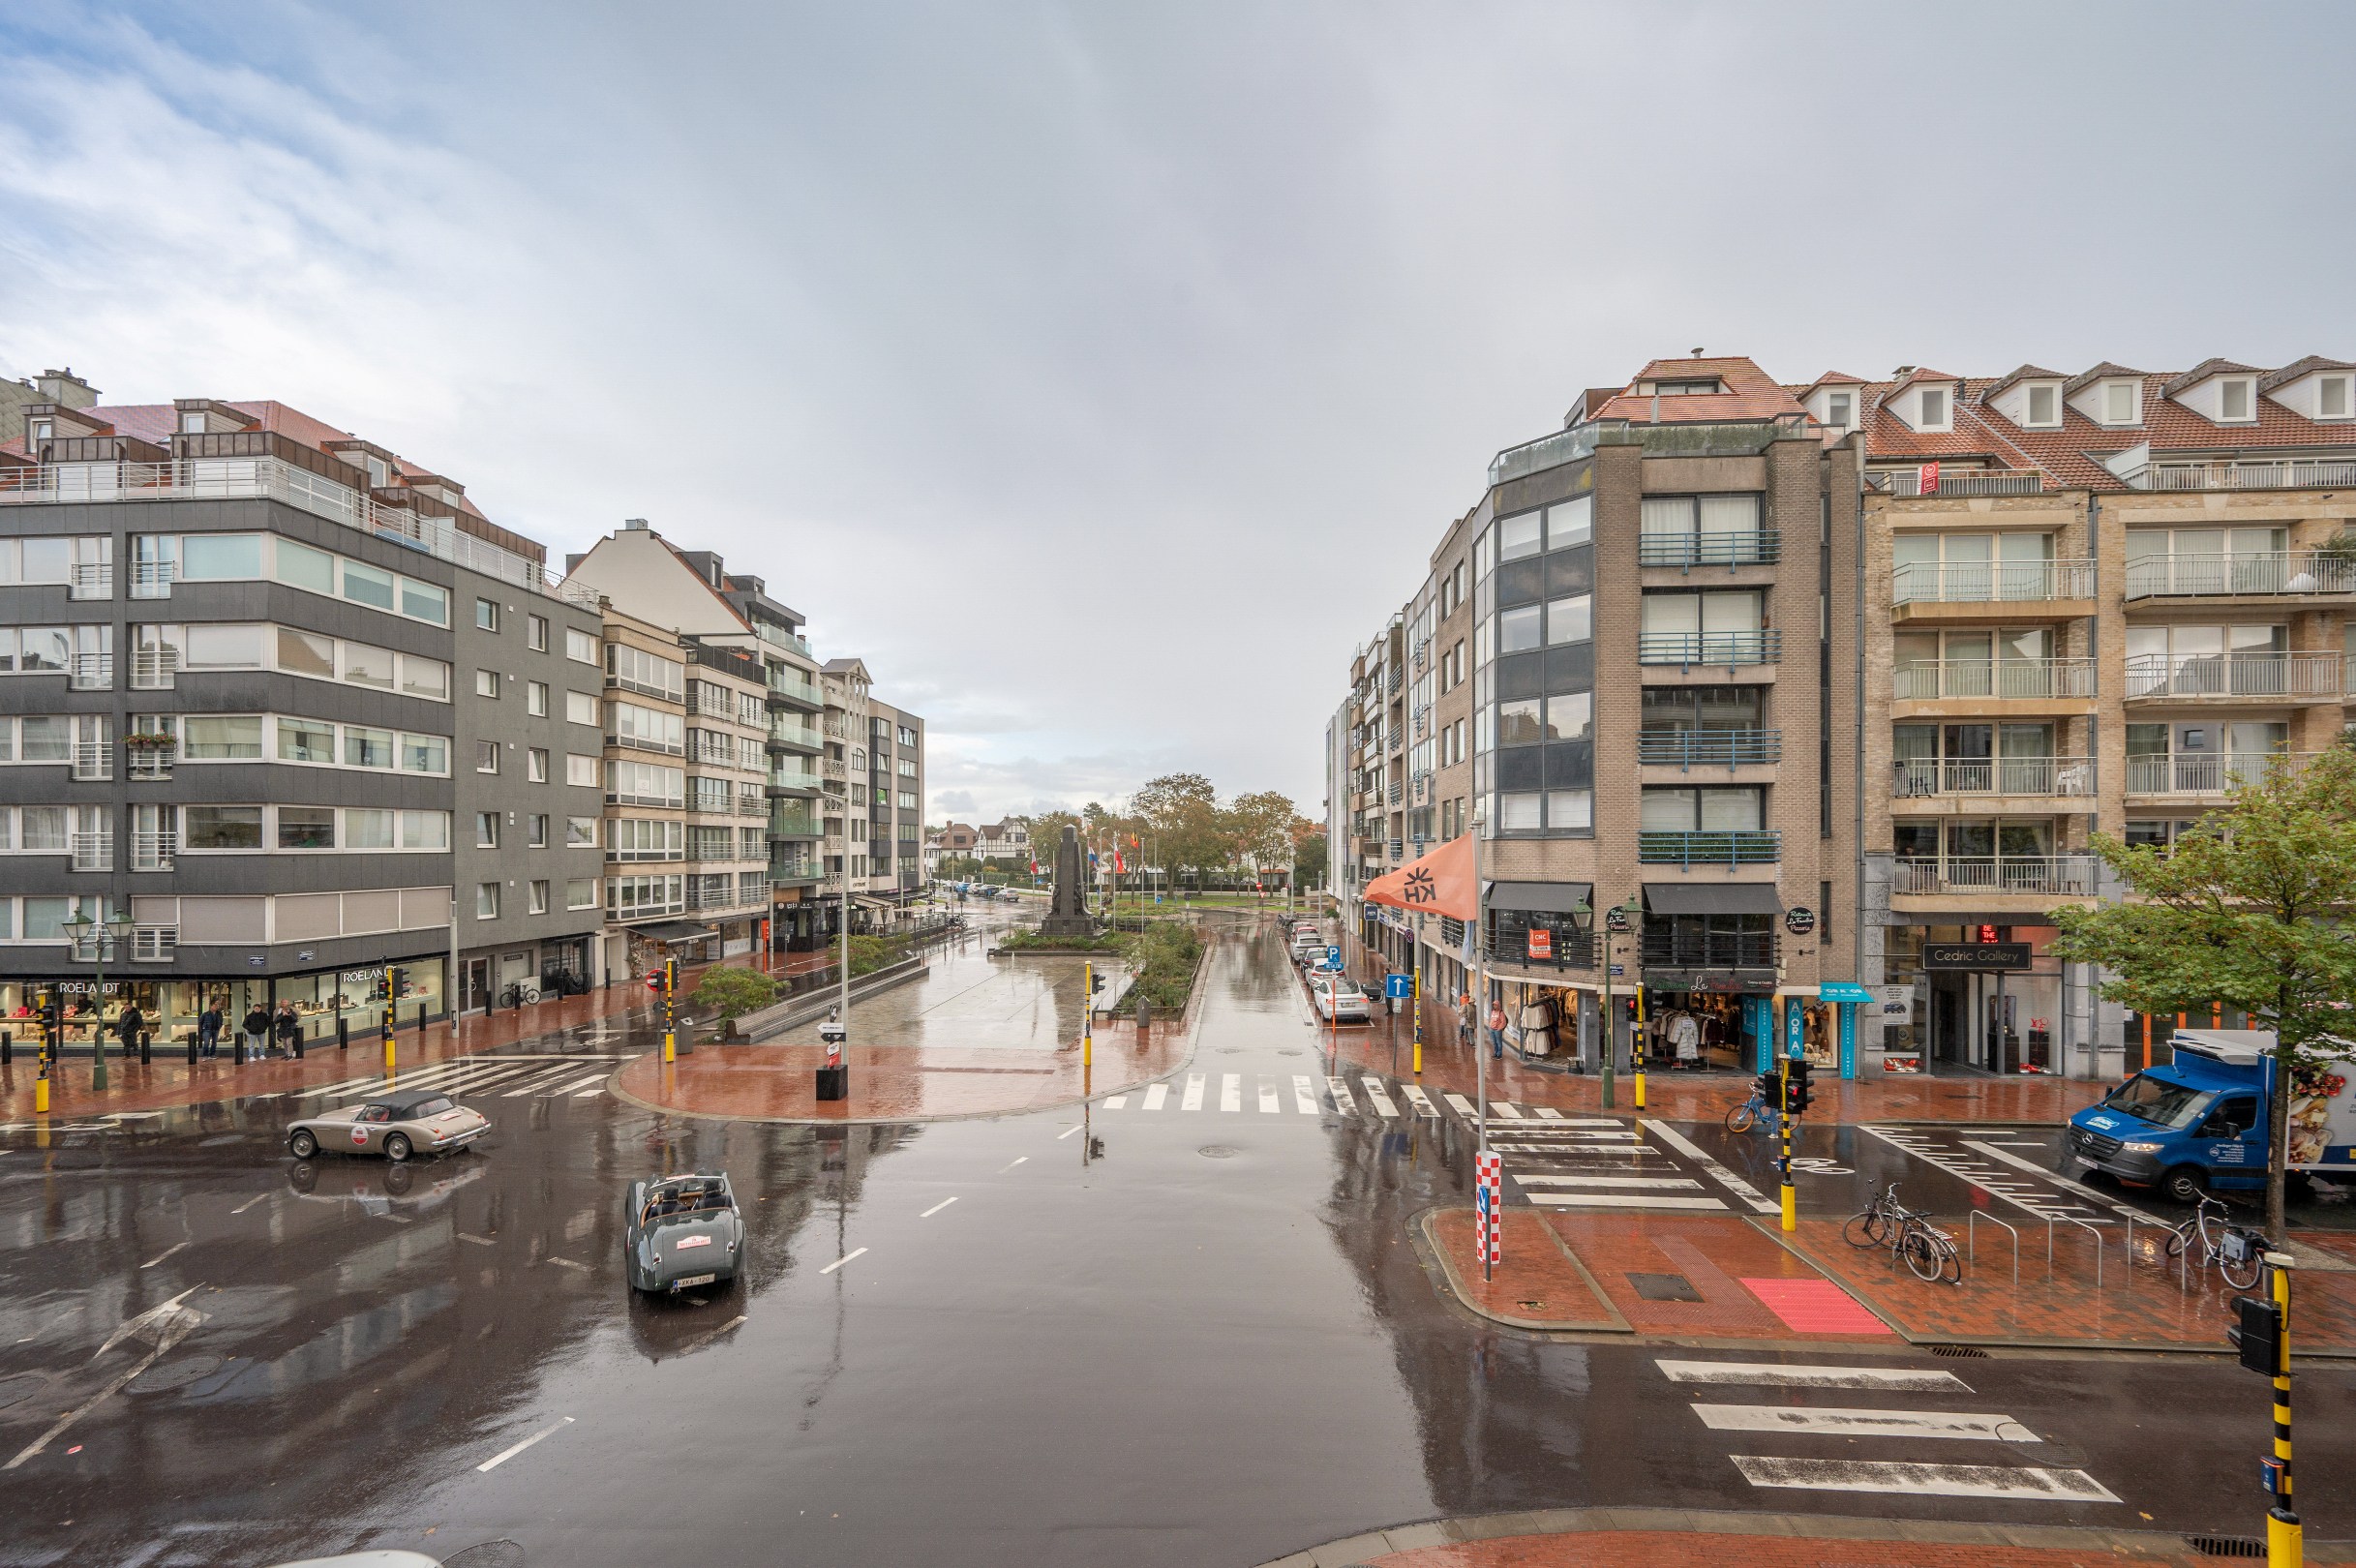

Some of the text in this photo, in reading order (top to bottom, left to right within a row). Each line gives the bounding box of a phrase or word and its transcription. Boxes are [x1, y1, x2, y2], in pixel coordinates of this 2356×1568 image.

[1329, 948, 1339, 959] P
[1934, 950, 2019, 962] Cedric Gallery
[1690, 975, 1708, 990] La
